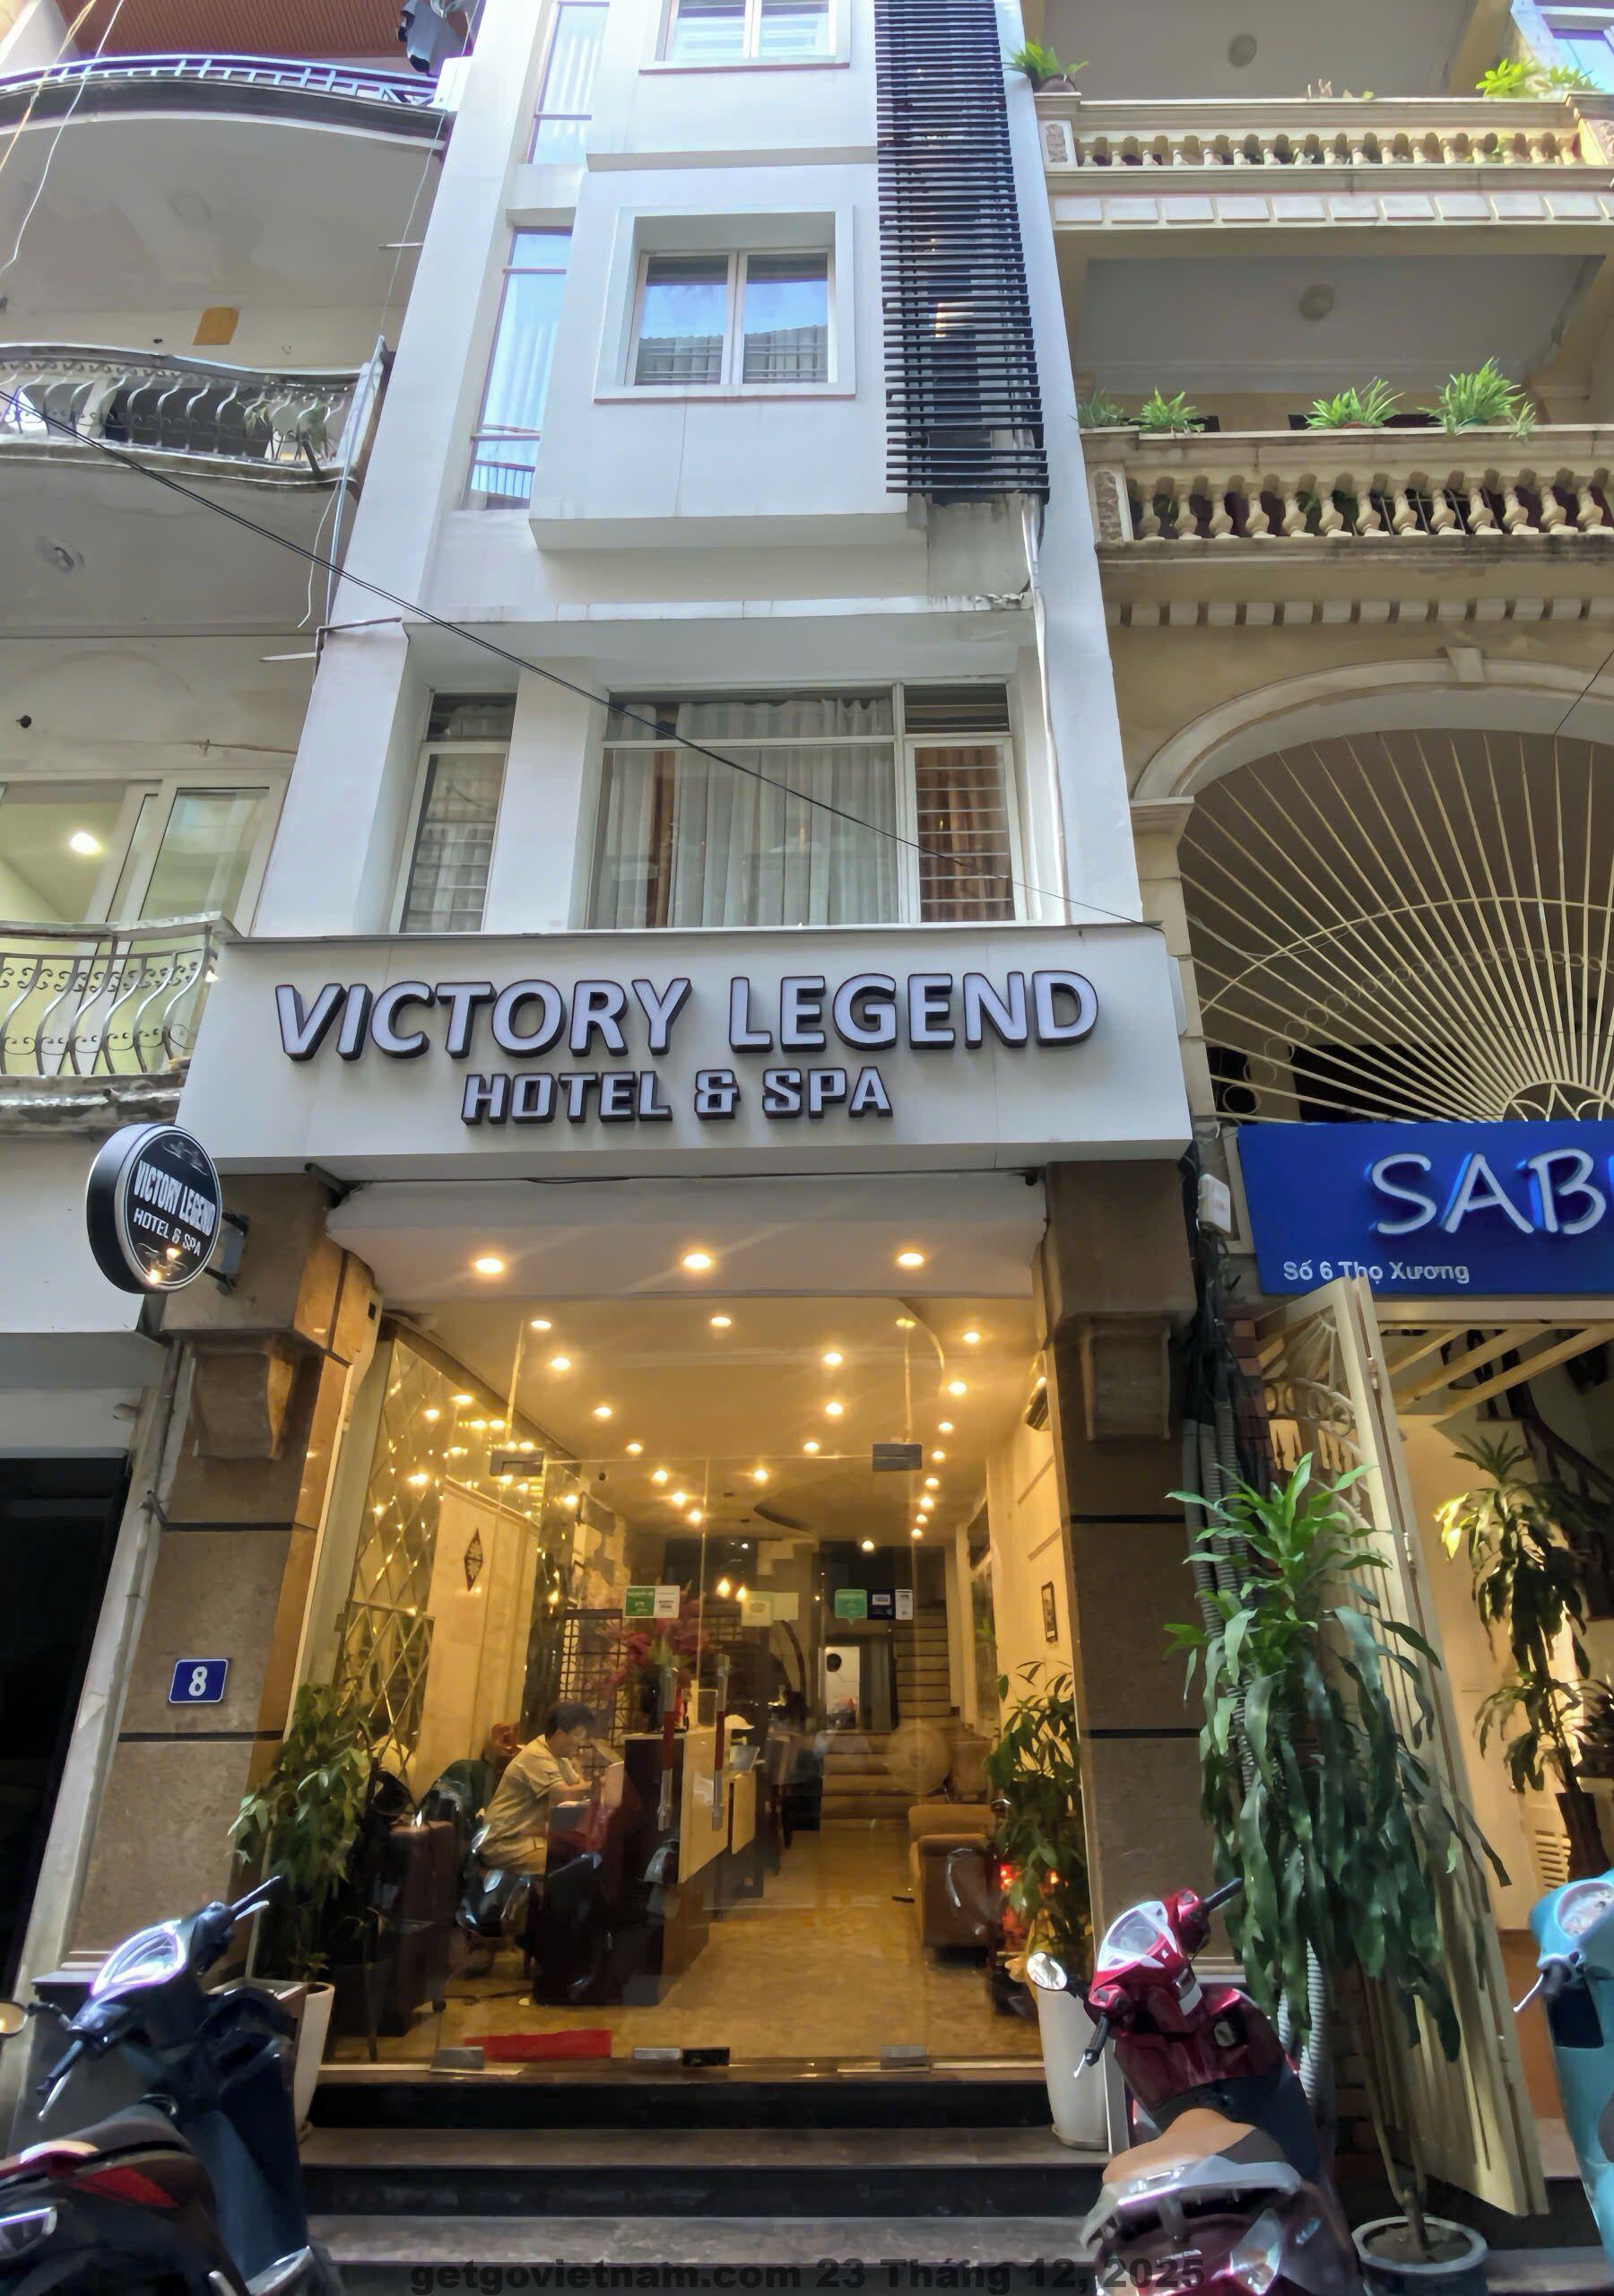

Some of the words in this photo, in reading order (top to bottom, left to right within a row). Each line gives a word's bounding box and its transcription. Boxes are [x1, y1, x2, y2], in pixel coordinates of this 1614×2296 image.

[275, 977, 691, 1061] VICTORY
[729, 970, 1099, 1054] LEGEND
[461, 1071, 672, 1125] HOTEL
[693, 1068, 740, 1120] &
[761, 1066, 894, 1118] SPA
[134, 1160, 182, 1215] VICTORY
[179, 1185, 216, 1237] LEGEND
[1364, 1148, 1614, 1236] SAB
[134, 1207, 169, 1239] HOTEL
[171, 1228, 181, 1244] &
[182, 1233, 202, 1257] SPA
[1283, 1259, 1313, 1281] Số
[1319, 1261, 1332, 1280] 6
[1338, 1261, 1383, 1284] Thọ
[1389, 1261, 1470, 1284] Xương
[188, 1665, 208, 1697] 8
